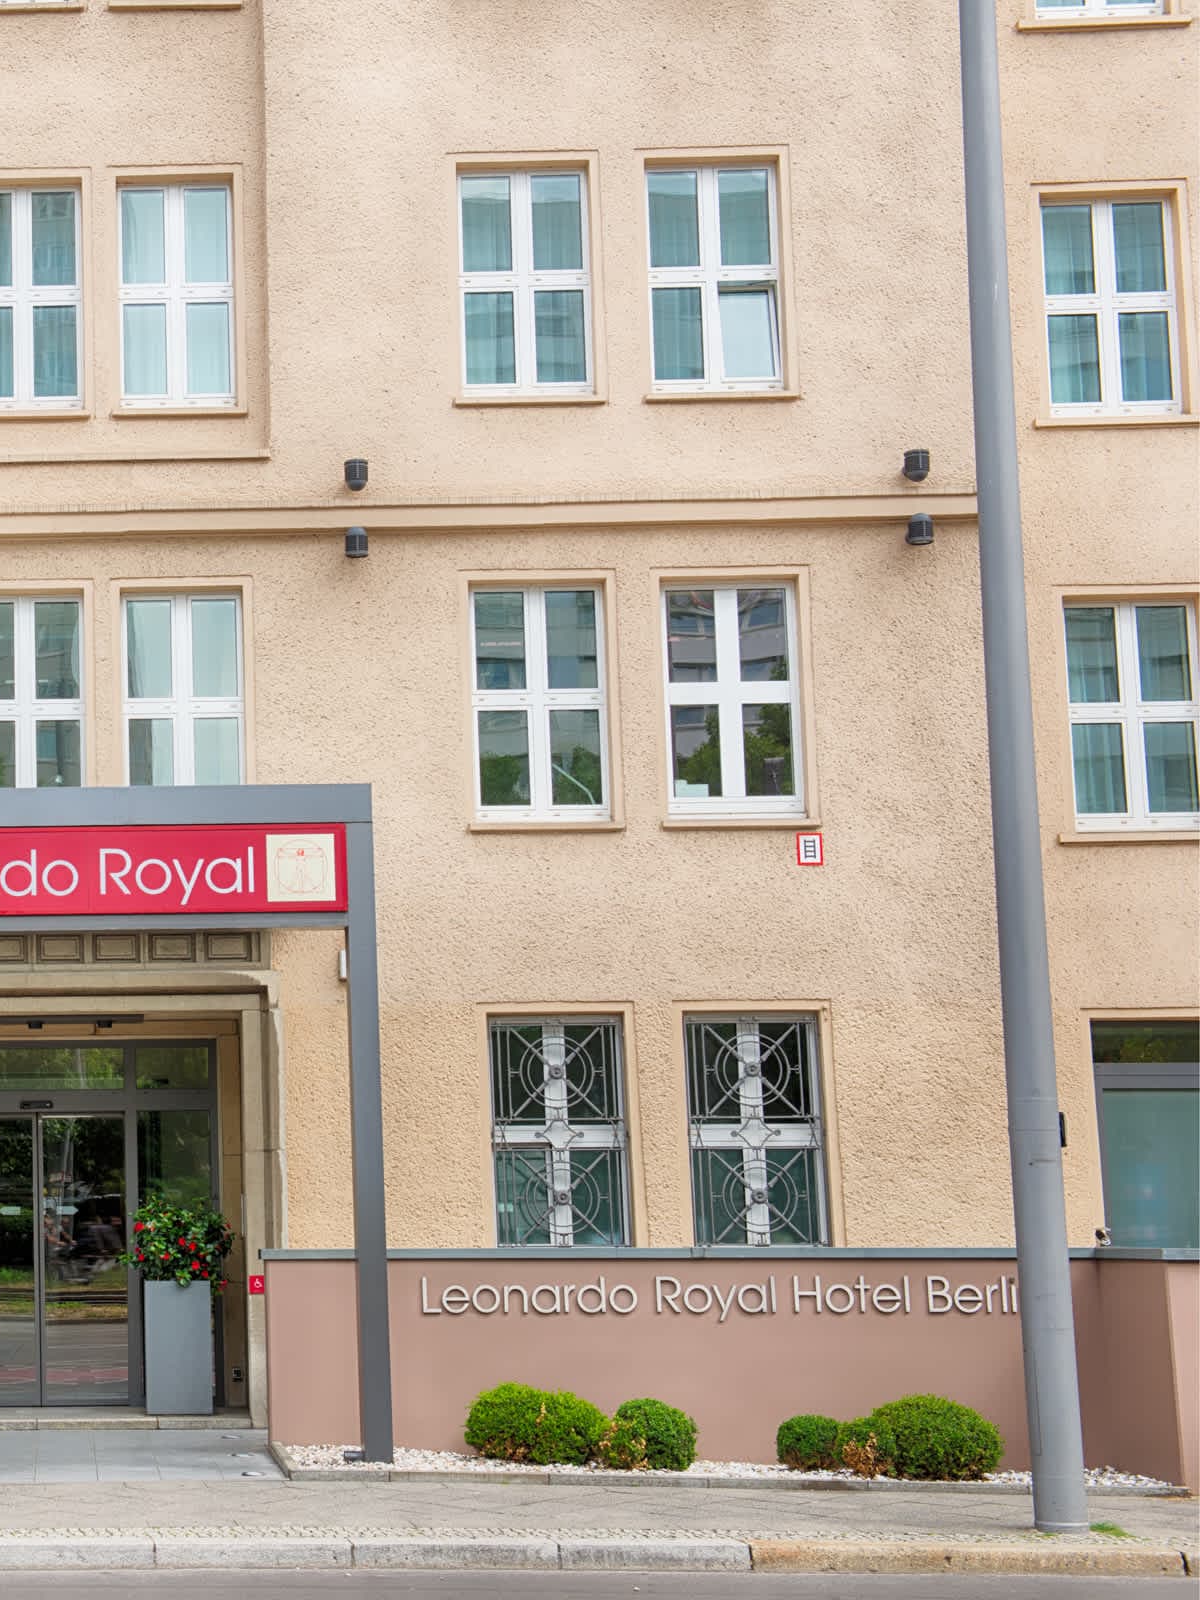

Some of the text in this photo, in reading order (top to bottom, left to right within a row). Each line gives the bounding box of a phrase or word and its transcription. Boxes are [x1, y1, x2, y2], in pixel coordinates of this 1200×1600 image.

[99, 846, 256, 906] Royal
[421, 1274, 1018, 1321] Leonardo Royal Hotel Berli
